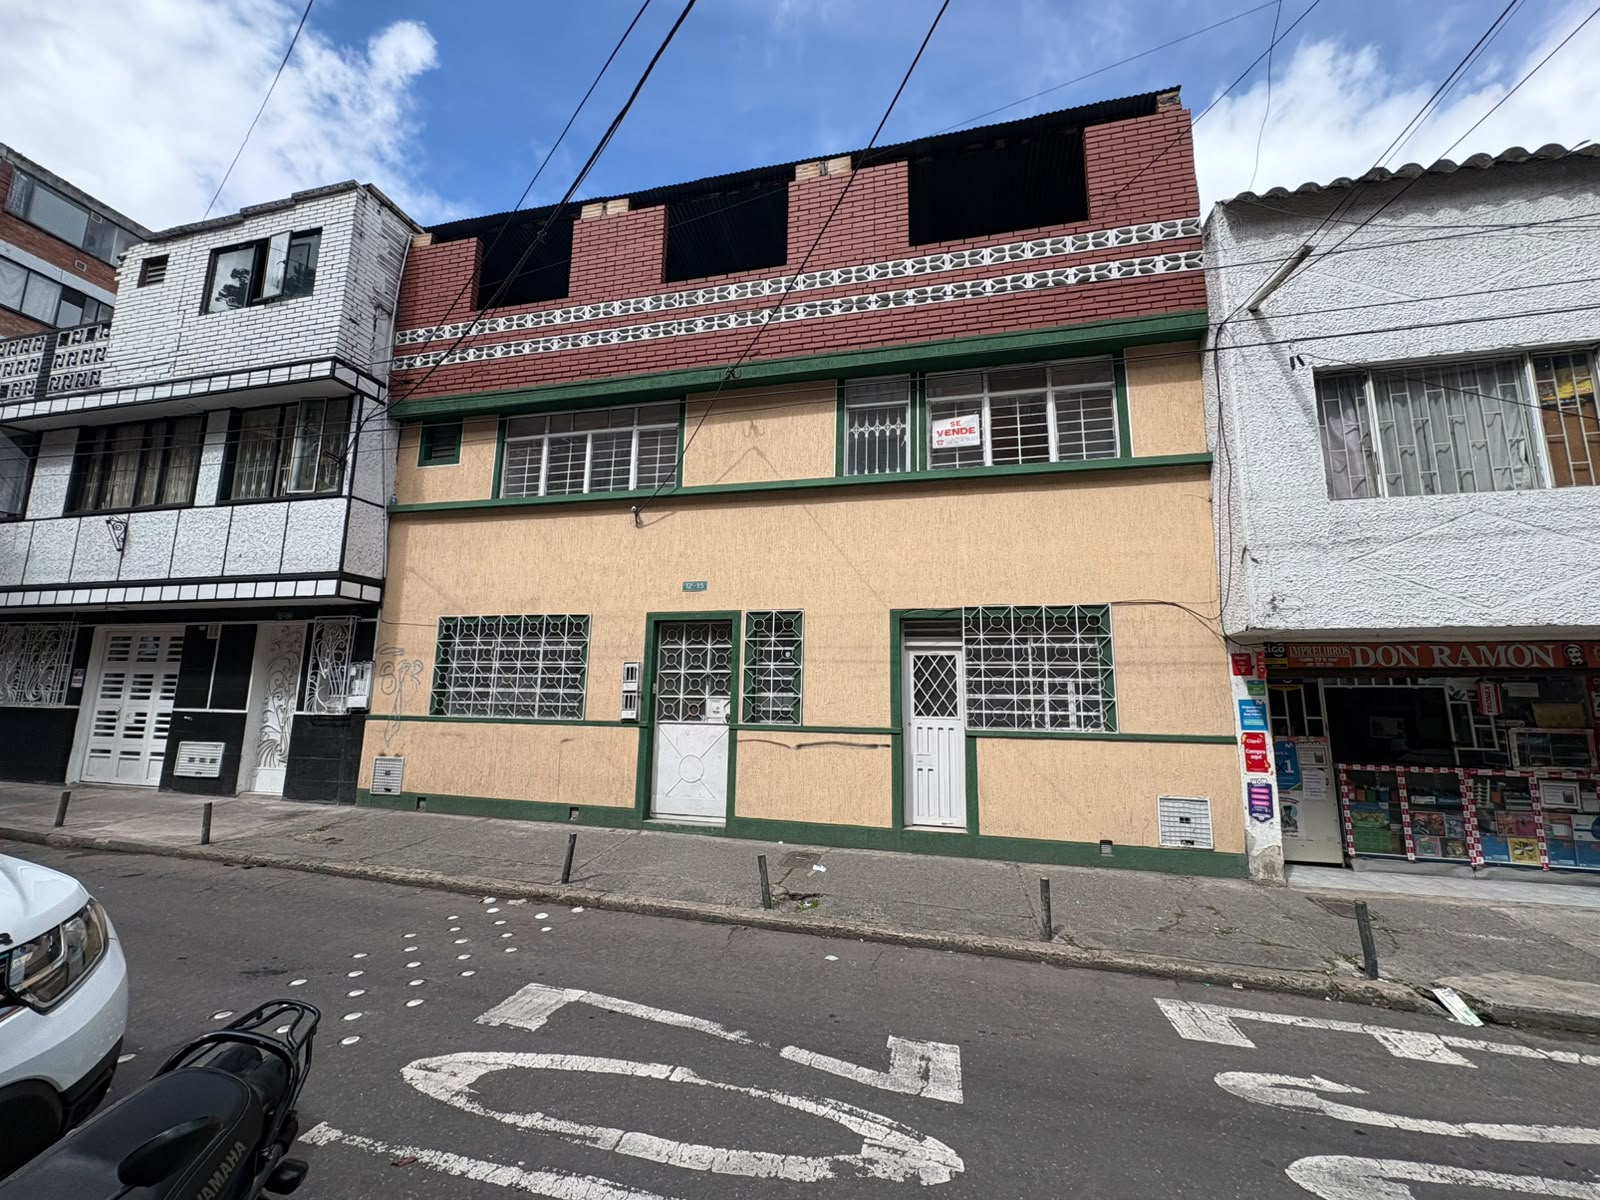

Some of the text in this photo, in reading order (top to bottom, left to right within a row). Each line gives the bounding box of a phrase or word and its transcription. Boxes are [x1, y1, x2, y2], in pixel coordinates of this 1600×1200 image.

[936, 426, 976, 437] VENDE
[1288, 645, 1350, 658] IMPRELIBROS
[1354, 645, 1420, 667] DON
